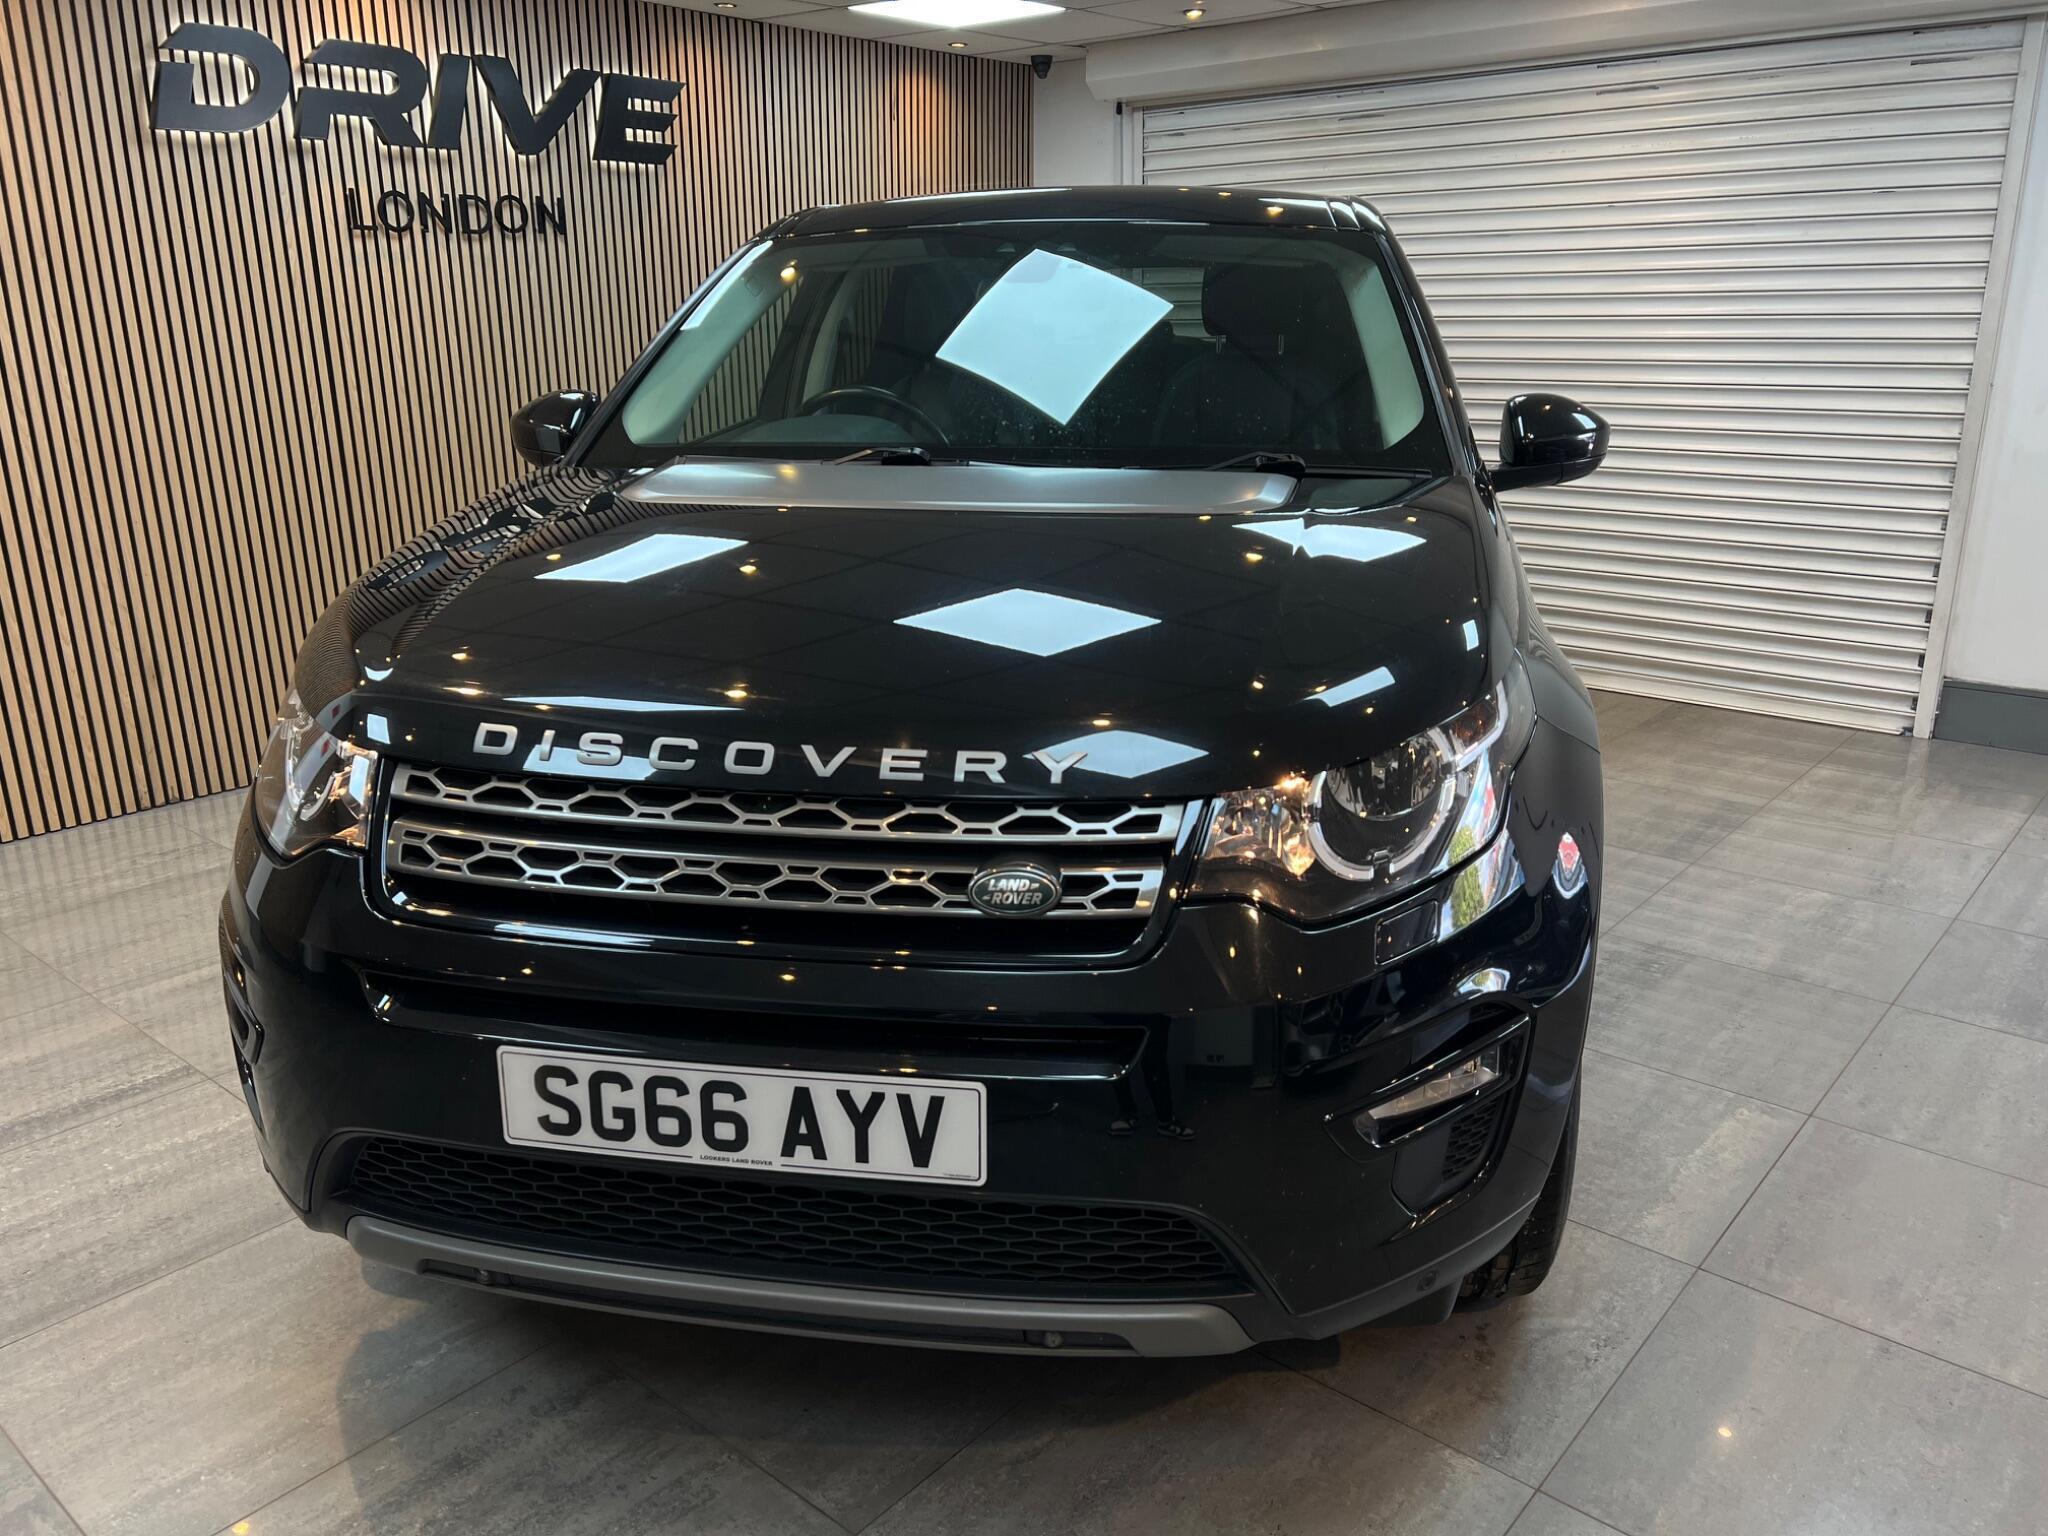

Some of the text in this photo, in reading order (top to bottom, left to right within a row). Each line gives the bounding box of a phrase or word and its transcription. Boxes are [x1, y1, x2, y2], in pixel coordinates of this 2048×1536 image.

[150, 22, 687, 165] DRIVE
[347, 187, 567, 236] LONDON
[472, 721, 1089, 784] DISCOVERY
[988, 878, 1031, 892] LAND
[991, 892, 1043, 905] ROVER
[534, 1064, 945, 1169] SG66 AYV
[700, 1154, 730, 1162] LOOKERS
